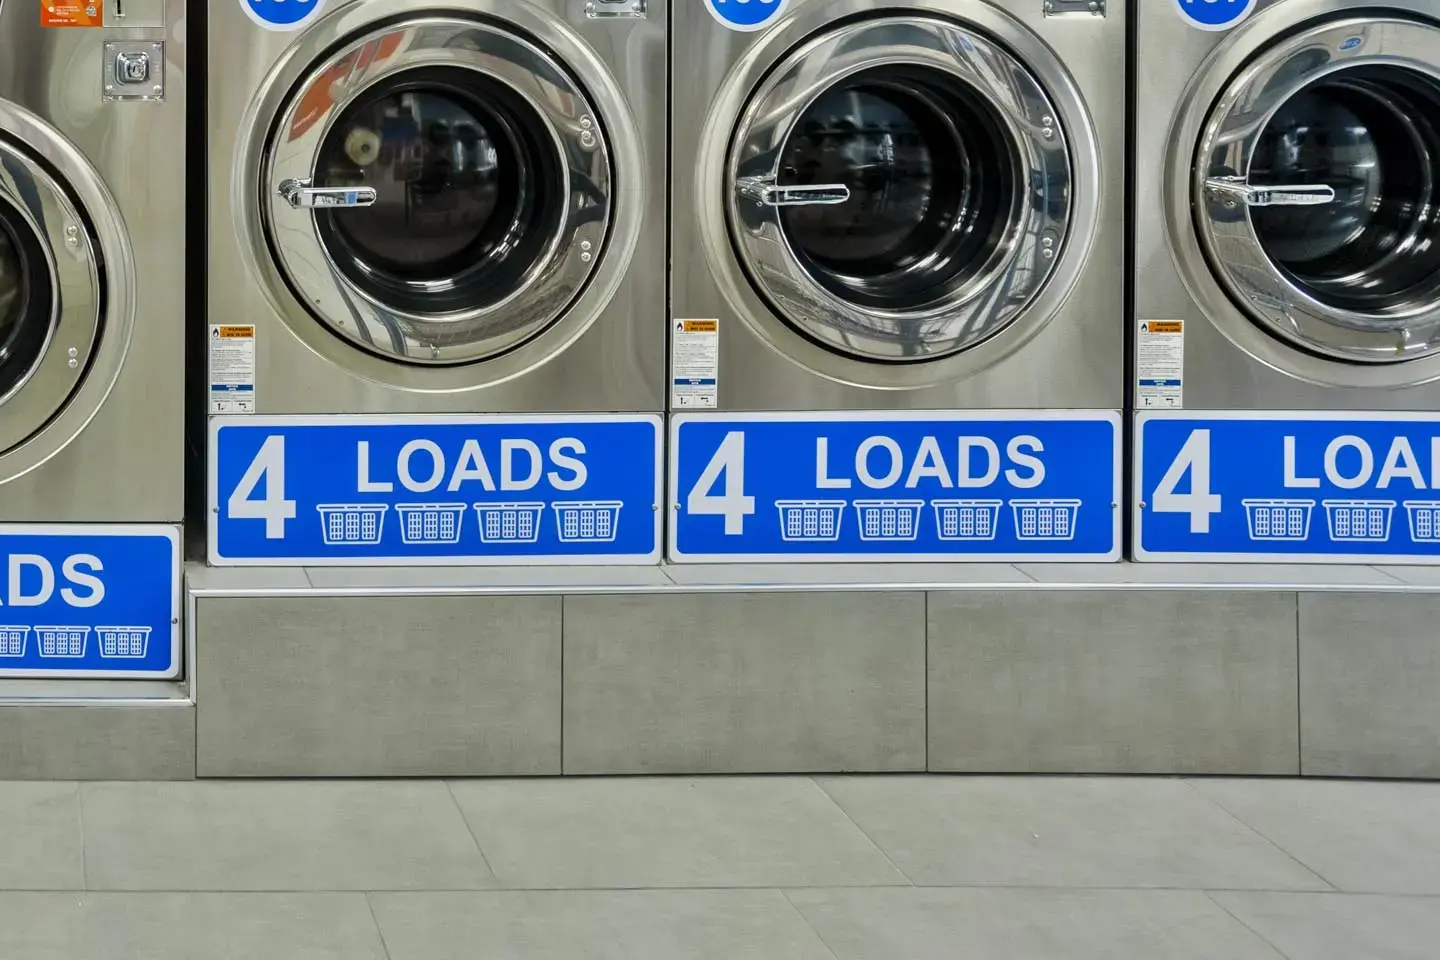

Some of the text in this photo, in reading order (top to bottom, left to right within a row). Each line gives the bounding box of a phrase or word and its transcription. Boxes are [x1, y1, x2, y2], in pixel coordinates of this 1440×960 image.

[228, 435, 588, 539] 4 LOADS
[687, 431, 1046, 535] 4 LOADS
[1152, 428, 1440, 534] 4 LOA
